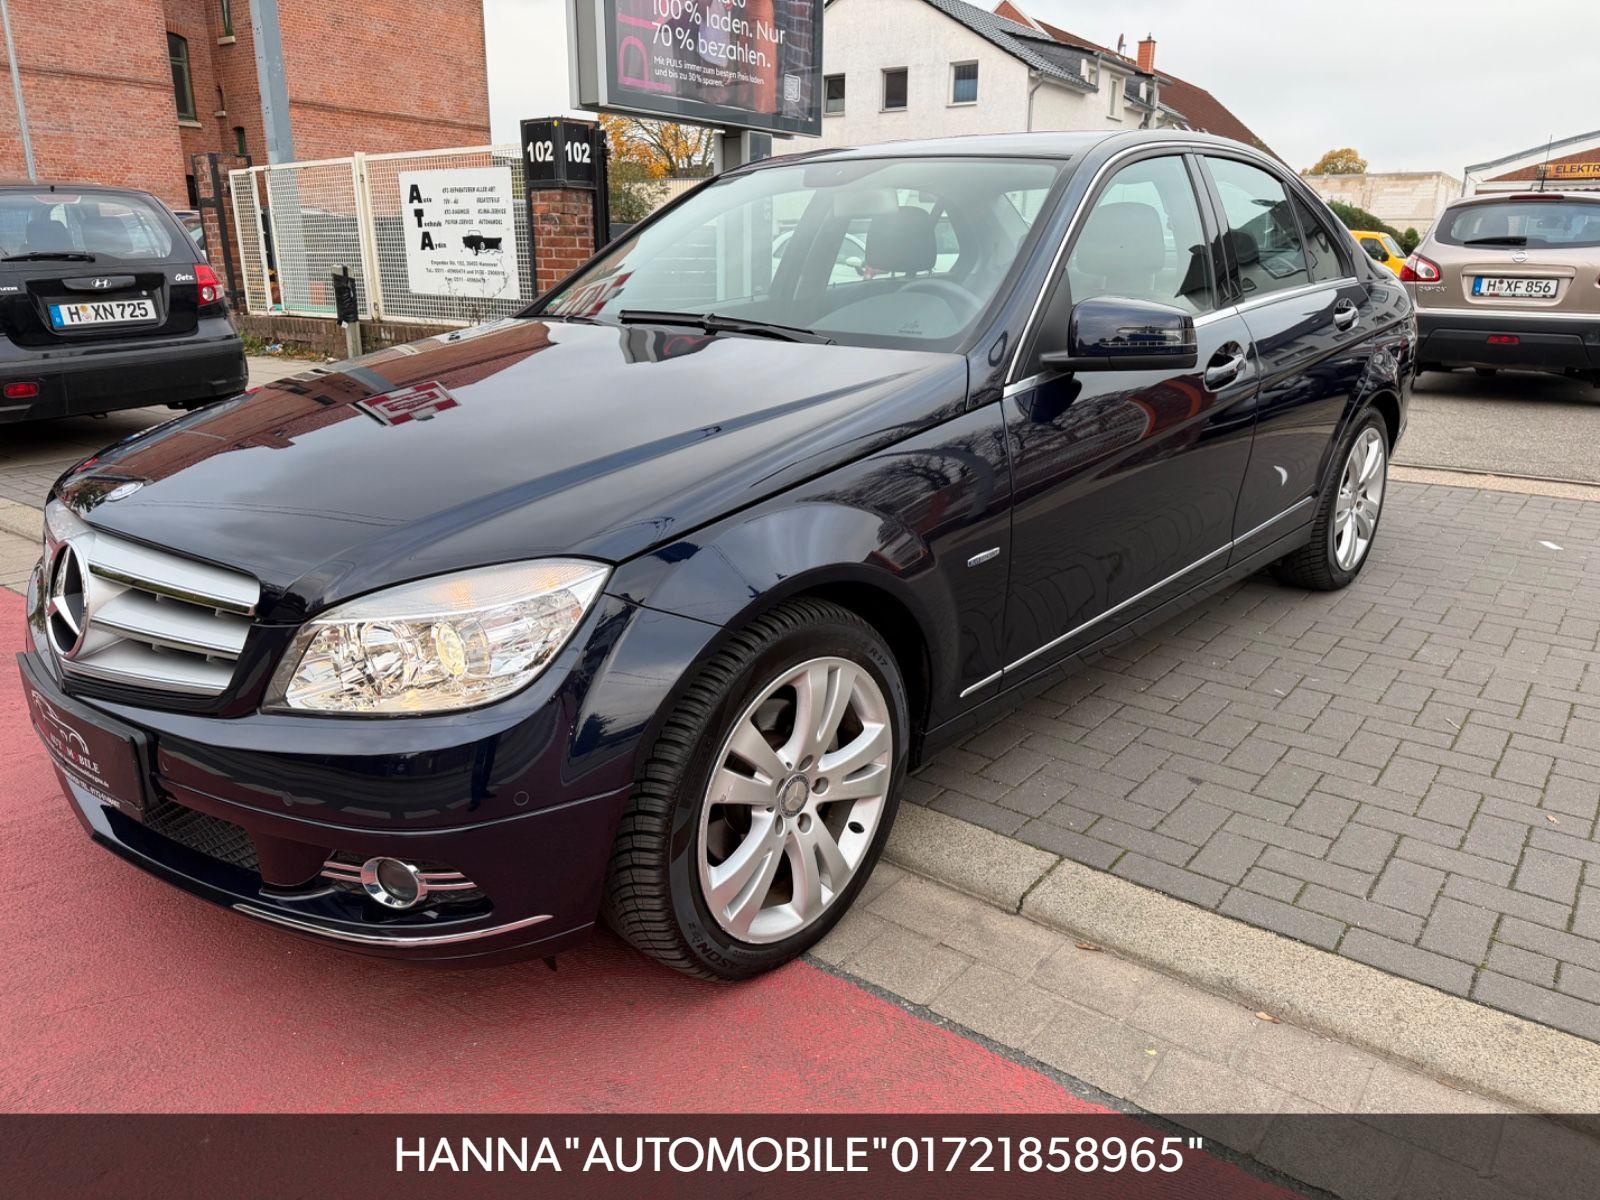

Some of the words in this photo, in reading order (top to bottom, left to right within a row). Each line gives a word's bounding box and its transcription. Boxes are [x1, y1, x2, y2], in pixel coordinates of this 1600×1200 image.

[706, 5, 753, 38] laden.
[756, 20, 786, 45] Nur
[651, 21, 673, 47] 70
[697, 31, 772, 68] bezahlen.
[655, 67, 667, 77] und
[665, 57, 683, 69] PULS
[527, 140, 554, 163] 102
[565, 140, 592, 164] 102
[1487, 280, 1497, 292] H
[1504, 282, 1522, 293] XF
[1525, 282, 1552, 294] 856
[67, 306, 82, 323] H
[91, 304, 116, 321] XN
[115, 302, 148, 319] 725
